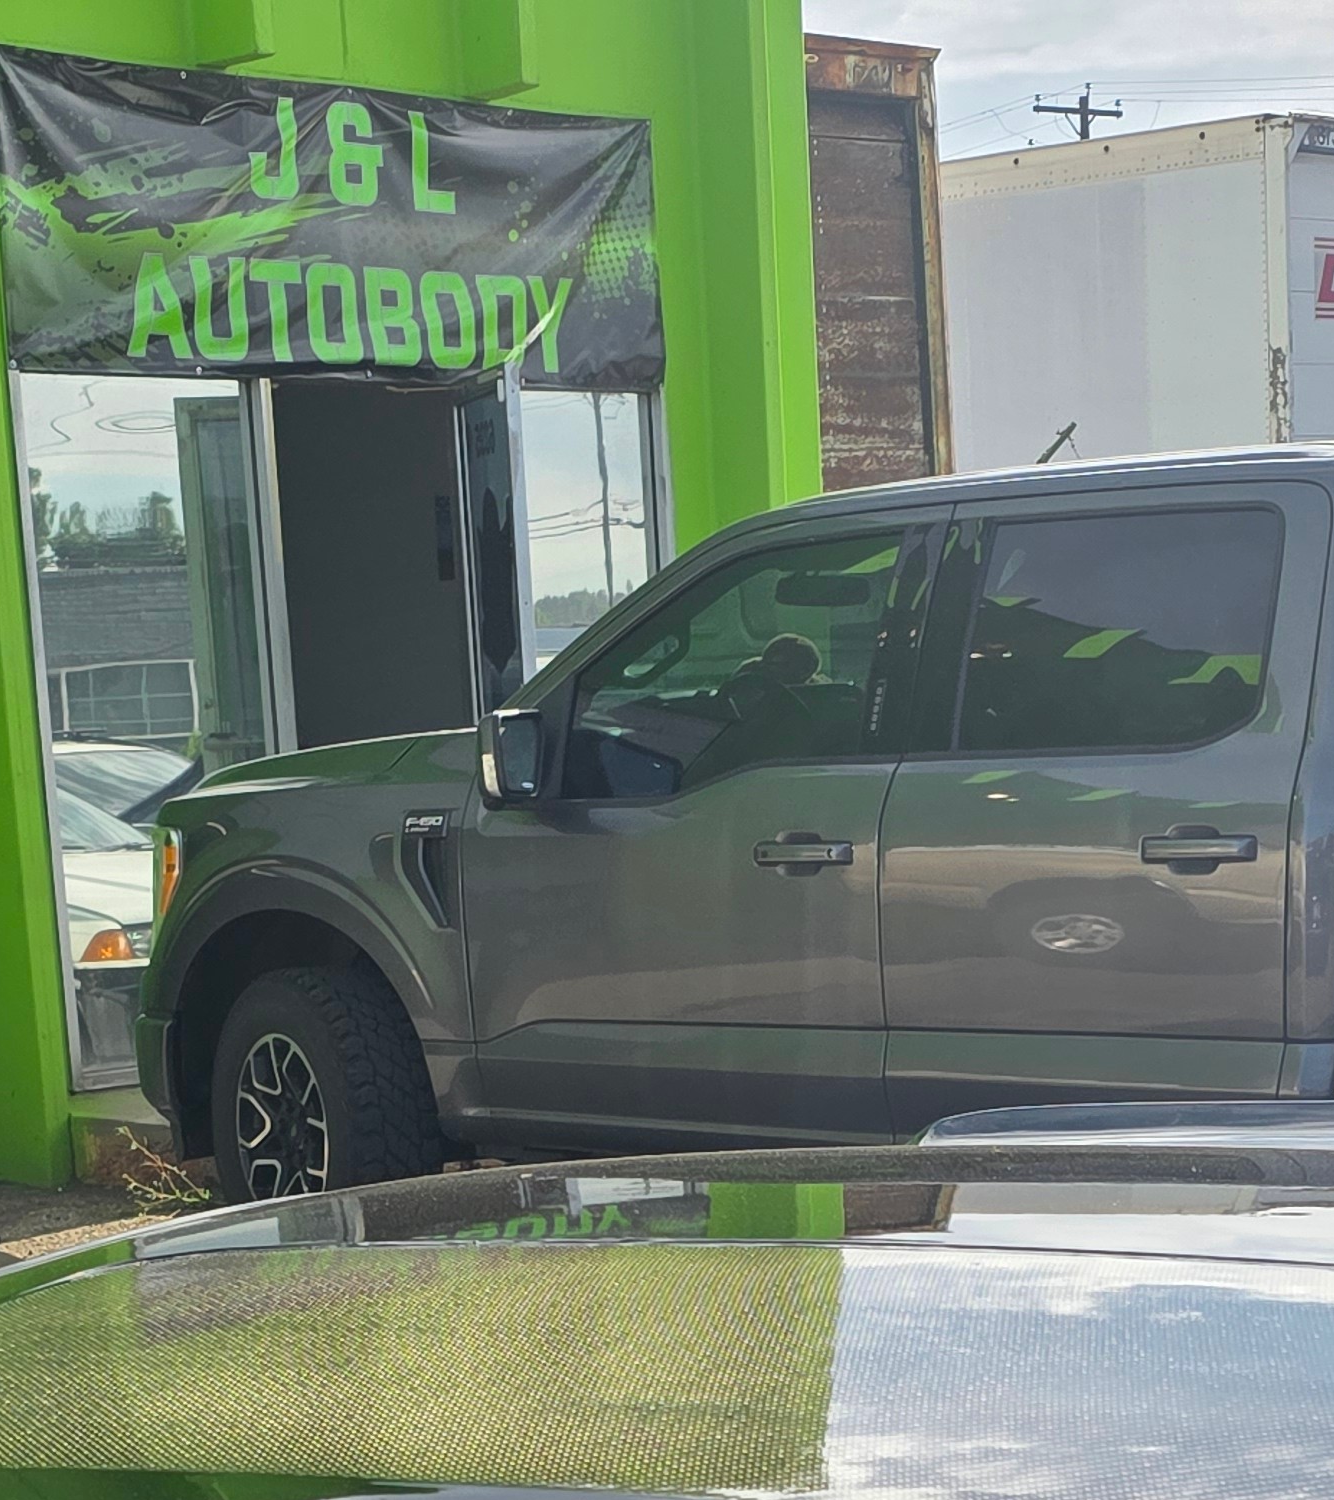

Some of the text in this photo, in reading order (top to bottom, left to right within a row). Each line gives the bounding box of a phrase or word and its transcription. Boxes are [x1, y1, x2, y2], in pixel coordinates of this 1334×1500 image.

[249, 96, 457, 215] J & L
[126, 252, 573, 374] AUTOBODY
